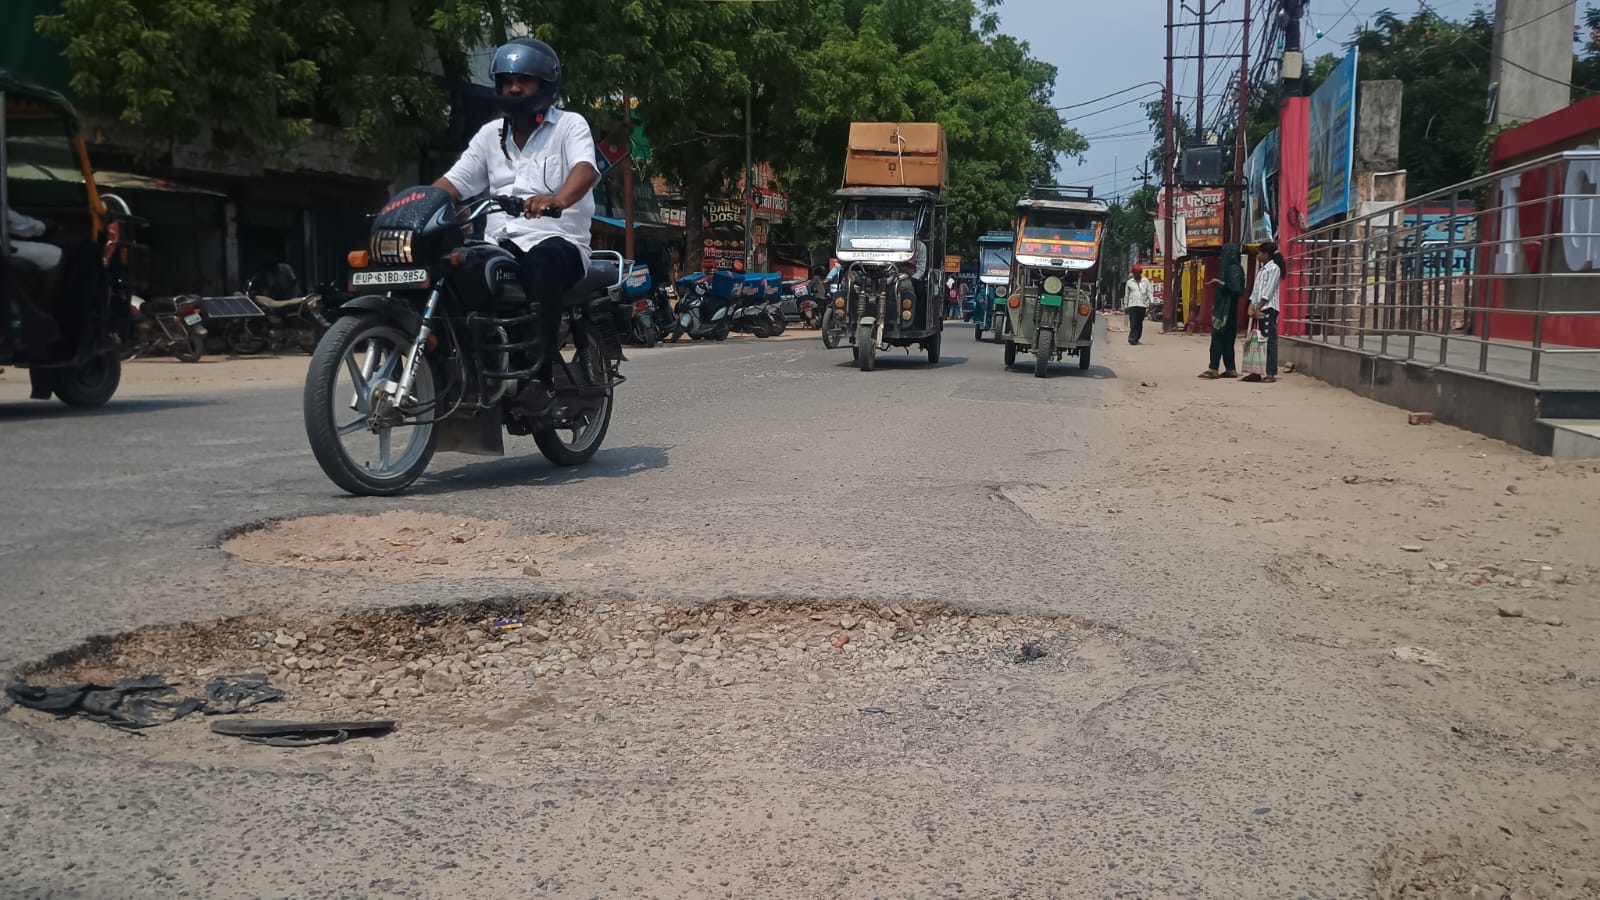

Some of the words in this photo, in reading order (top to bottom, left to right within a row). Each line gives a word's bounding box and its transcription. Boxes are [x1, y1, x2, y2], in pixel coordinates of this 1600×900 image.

[710, 203, 740, 213] DAILY
[711, 213, 740, 222] DOSE
[362, 273, 373, 283] UP
